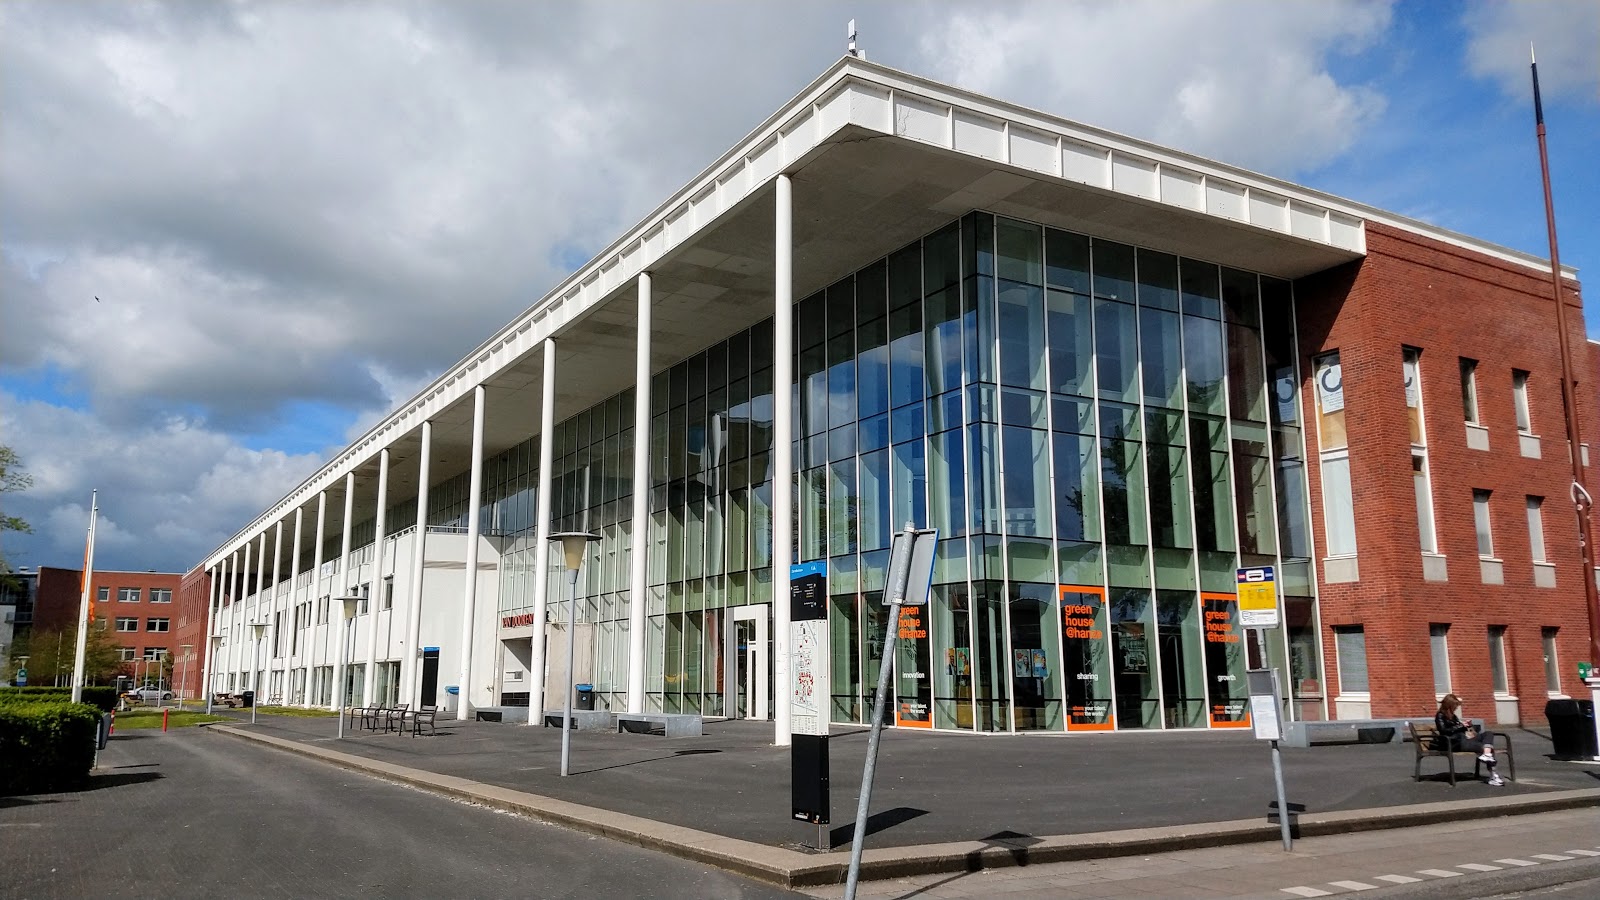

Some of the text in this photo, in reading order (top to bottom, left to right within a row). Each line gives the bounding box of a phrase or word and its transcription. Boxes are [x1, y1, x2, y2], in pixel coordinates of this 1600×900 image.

[900, 606, 919, 617] green
[1064, 604, 1093, 616] green
[1205, 611, 1230, 621] green
[898, 618, 921, 627] house
[1065, 616, 1095, 627] house
[1206, 621, 1233, 631] house
[898, 629, 927, 639] @hanze
[1066, 627, 1103, 639] @hanze
[1207, 632, 1239, 643] @hanze
[1076, 672, 1099, 681] sharing
[1217, 674, 1237, 682] growth
